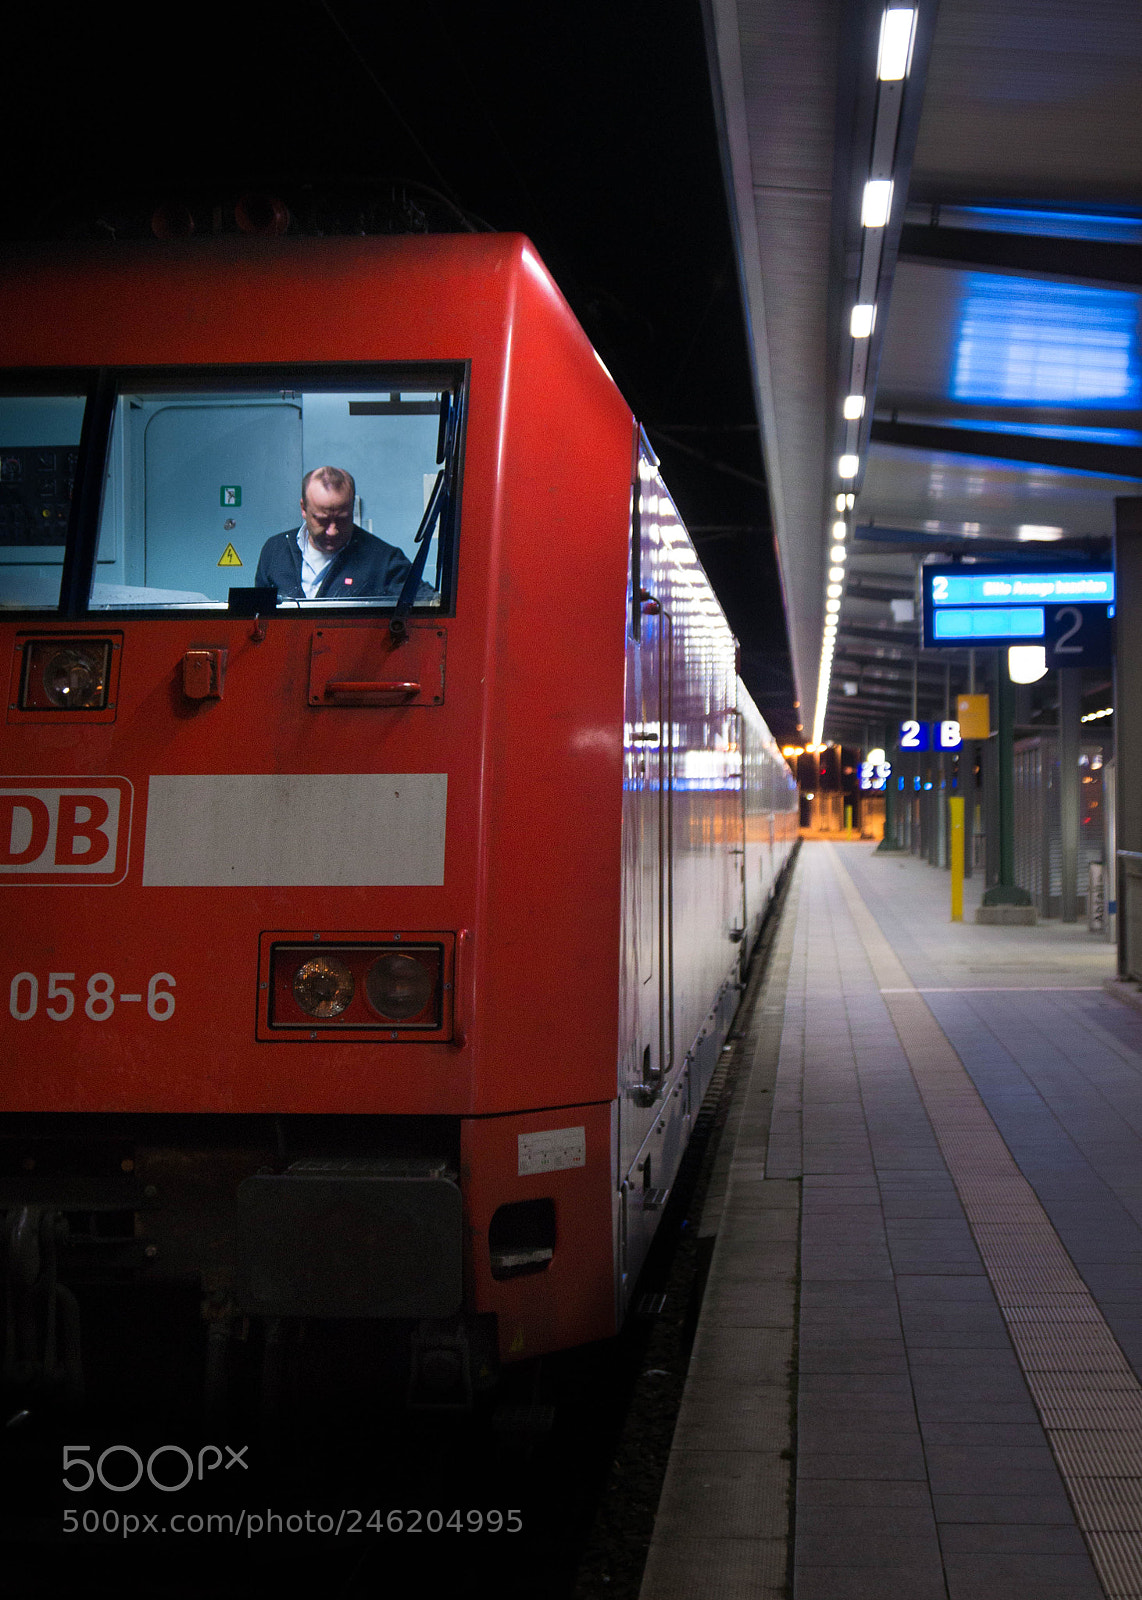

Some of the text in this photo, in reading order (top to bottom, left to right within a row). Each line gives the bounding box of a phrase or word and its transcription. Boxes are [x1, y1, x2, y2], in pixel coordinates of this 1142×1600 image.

[933, 576, 949, 599] 2
[1055, 606, 1084, 654] 2
[901, 720, 961, 747] 2 B
[0, 794, 110, 866] DB
[9, 971, 177, 1022] 058-6
